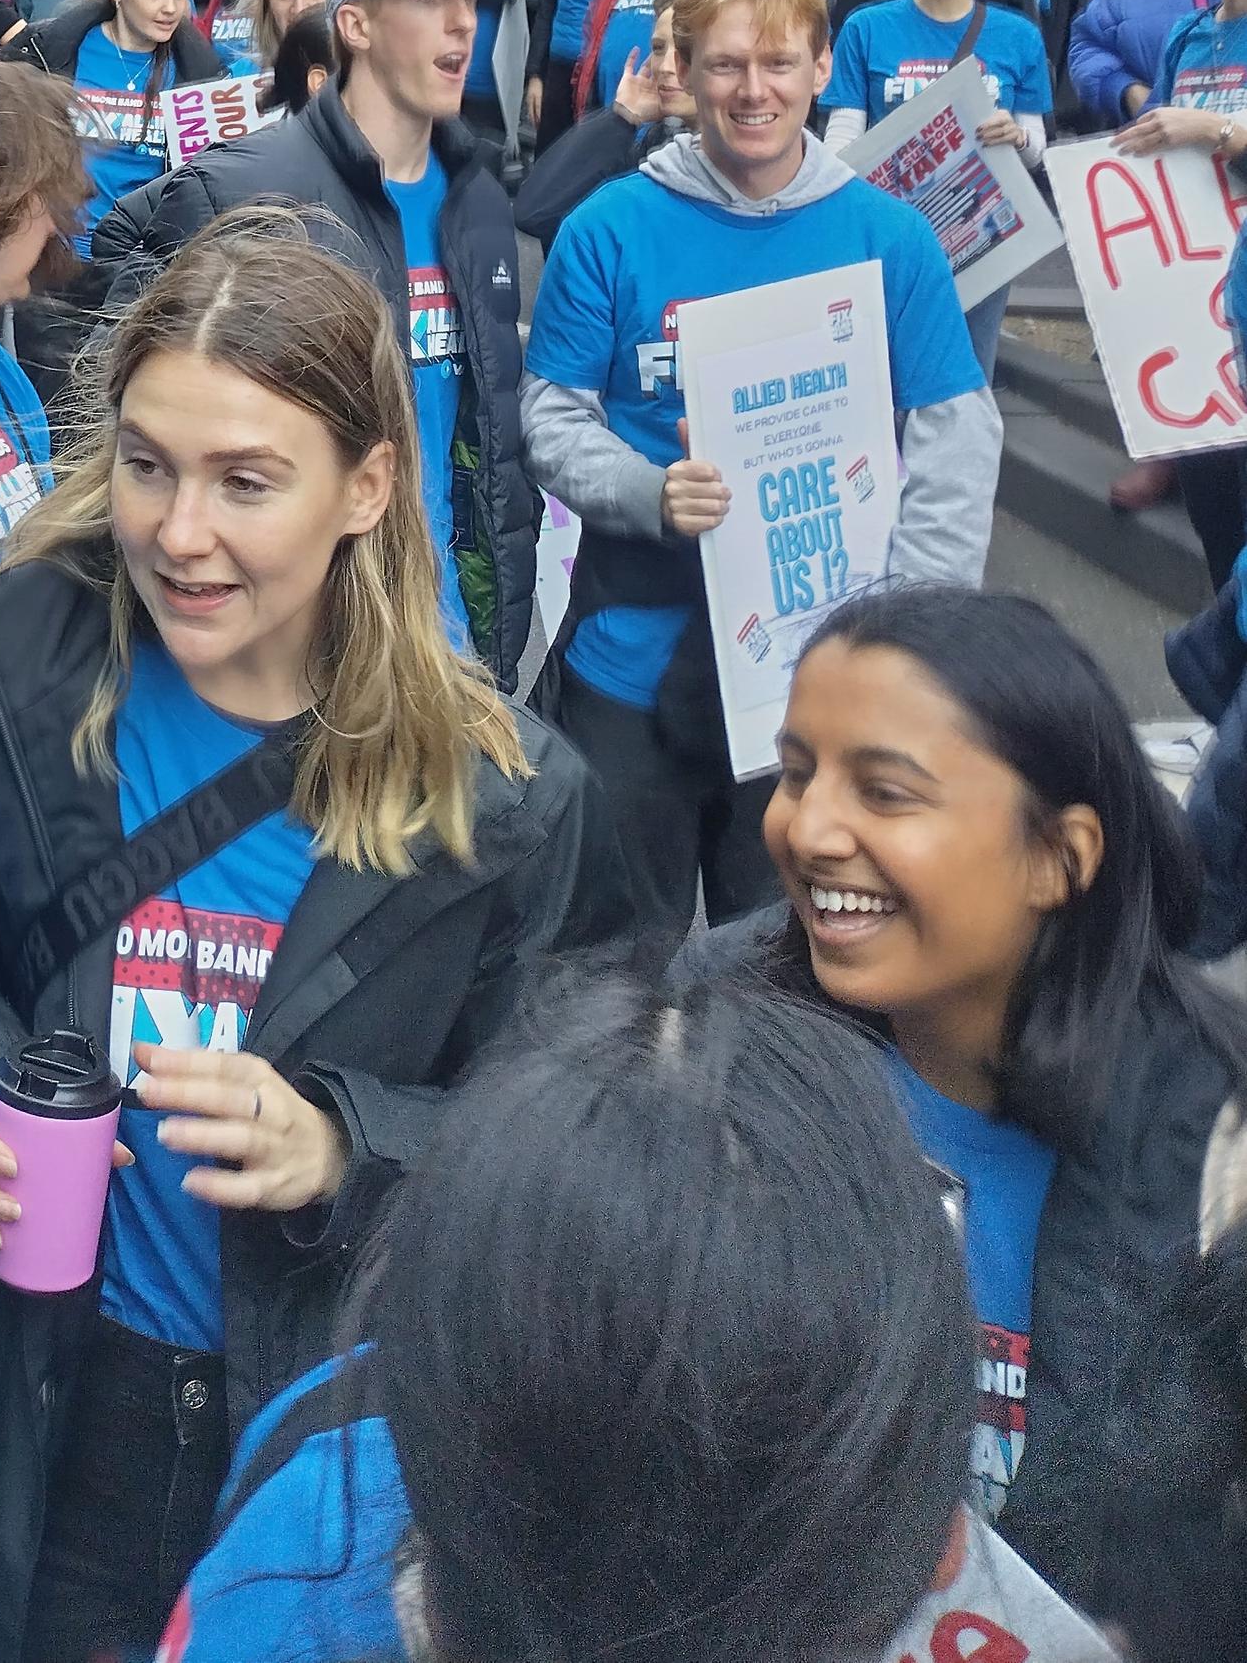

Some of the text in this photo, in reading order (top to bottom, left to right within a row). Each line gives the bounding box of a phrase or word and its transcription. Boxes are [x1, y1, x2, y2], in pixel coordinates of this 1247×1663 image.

[211, 83, 248, 139] OUR
[866, 104, 955, 184] WE'RE NOT
[414, 280, 445, 296] BAND
[665, 314, 679, 329] N
[635, 341, 686, 392] FI
[731, 361, 848, 415] ALLIED HEALTH
[735, 396, 849, 434] WE PROVIDE CARE TO
[763, 422, 823, 446] EVERYONE
[743, 434, 844, 470] BUT WHO'S GONNA
[757, 456, 841, 523] CARE
[766, 508, 845, 568] ABOUT
[771, 560, 815, 617] US
[59, 787, 239, 939] BAGGU
[137, 928, 192, 959] MO
[978, 1360, 1027, 1398] ND
